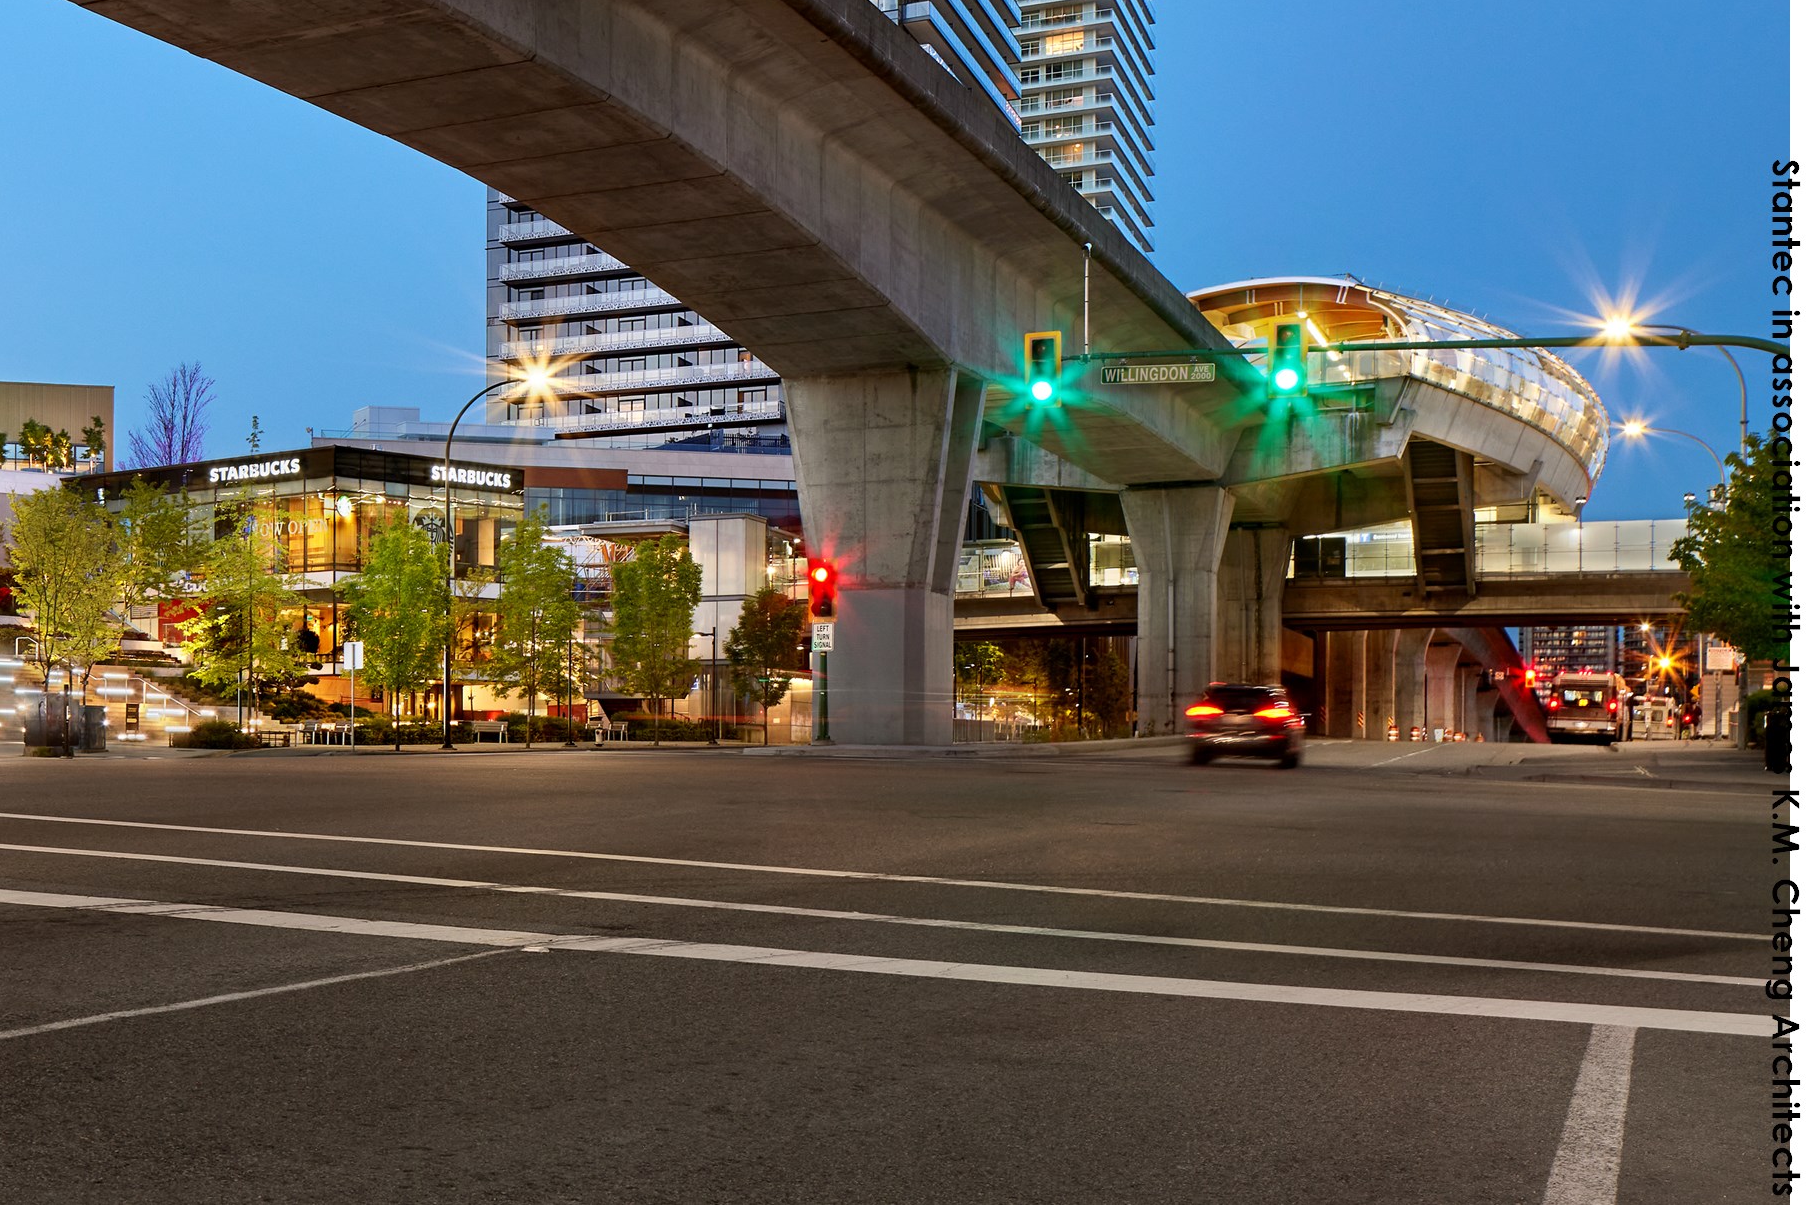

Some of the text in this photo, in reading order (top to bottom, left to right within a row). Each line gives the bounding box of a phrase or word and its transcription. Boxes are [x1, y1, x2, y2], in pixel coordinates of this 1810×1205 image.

[1105, 366, 1188, 382] WILLINGDON
[1190, 372, 1211, 380] 2000
[1193, 365, 1210, 373] AVE
[209, 457, 301, 484] STARBUCKS
[430, 465, 511, 489] STARBUCKS
[287, 516, 328, 535] OPEN
[813, 641, 832, 649] SIGNAL
